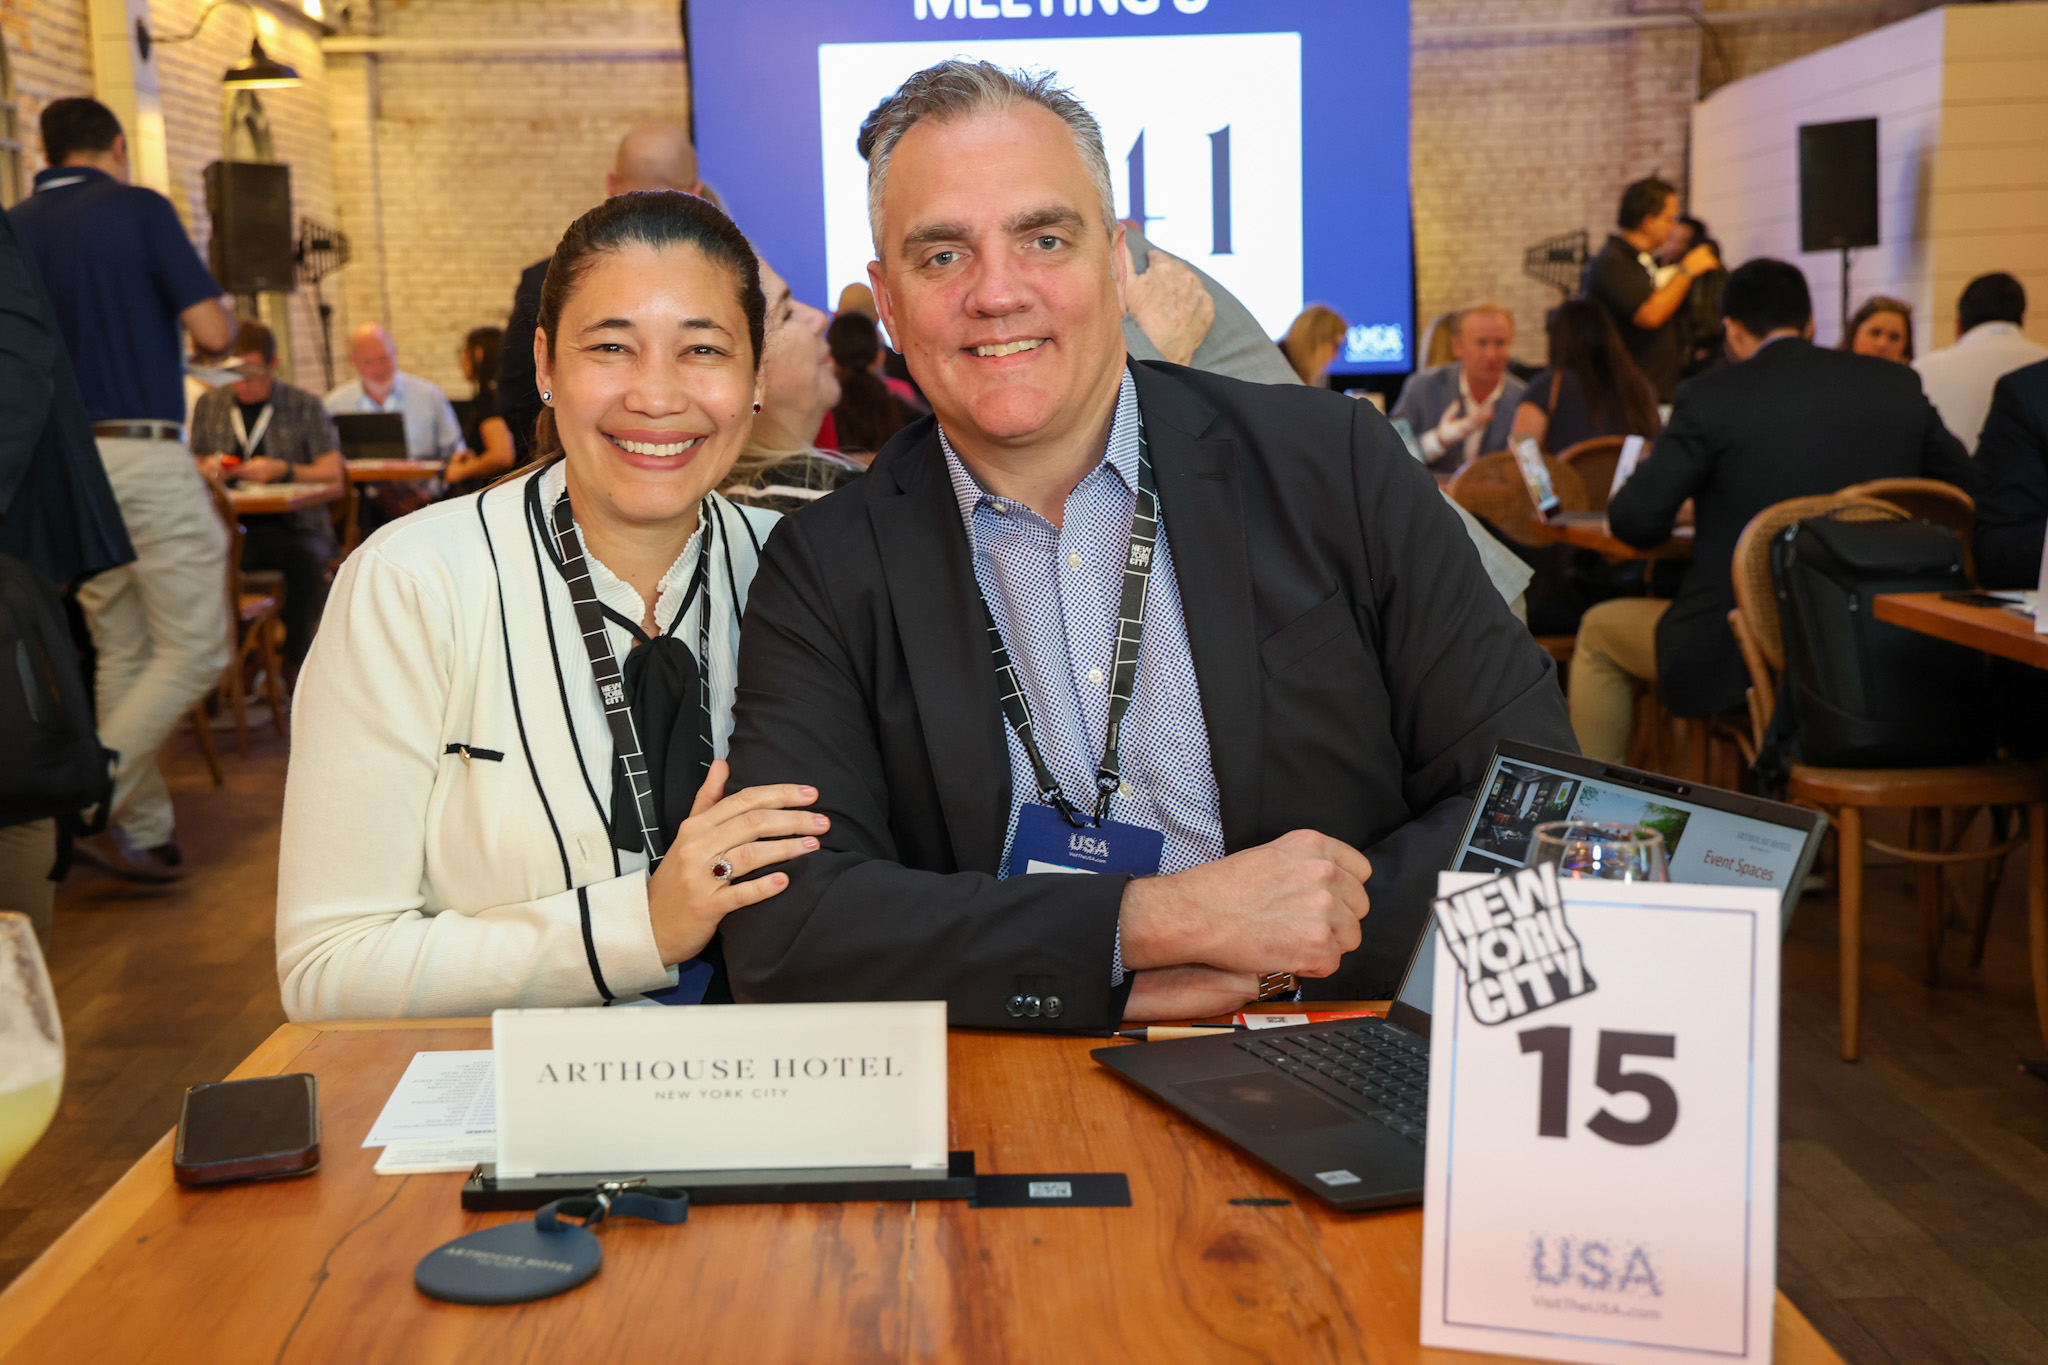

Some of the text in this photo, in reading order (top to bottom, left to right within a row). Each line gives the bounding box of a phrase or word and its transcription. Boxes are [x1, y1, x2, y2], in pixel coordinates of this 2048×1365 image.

[601, 682, 622, 693] NEW
[605, 692, 625, 705] CITY
[1068, 832, 1109, 858] USA
[1703, 849, 1775, 882] Event Spaces
[1434, 861, 1560, 942] NEW
[1449, 905, 1576, 984] YORK
[1468, 948, 1585, 1024] CITY
[537, 1055, 904, 1084] ARTHOUSE HOTEL
[1518, 1025, 1680, 1147] 15
[654, 1087, 789, 1100] NEW YORK CITY
[1530, 1233, 1664, 1297] USA
